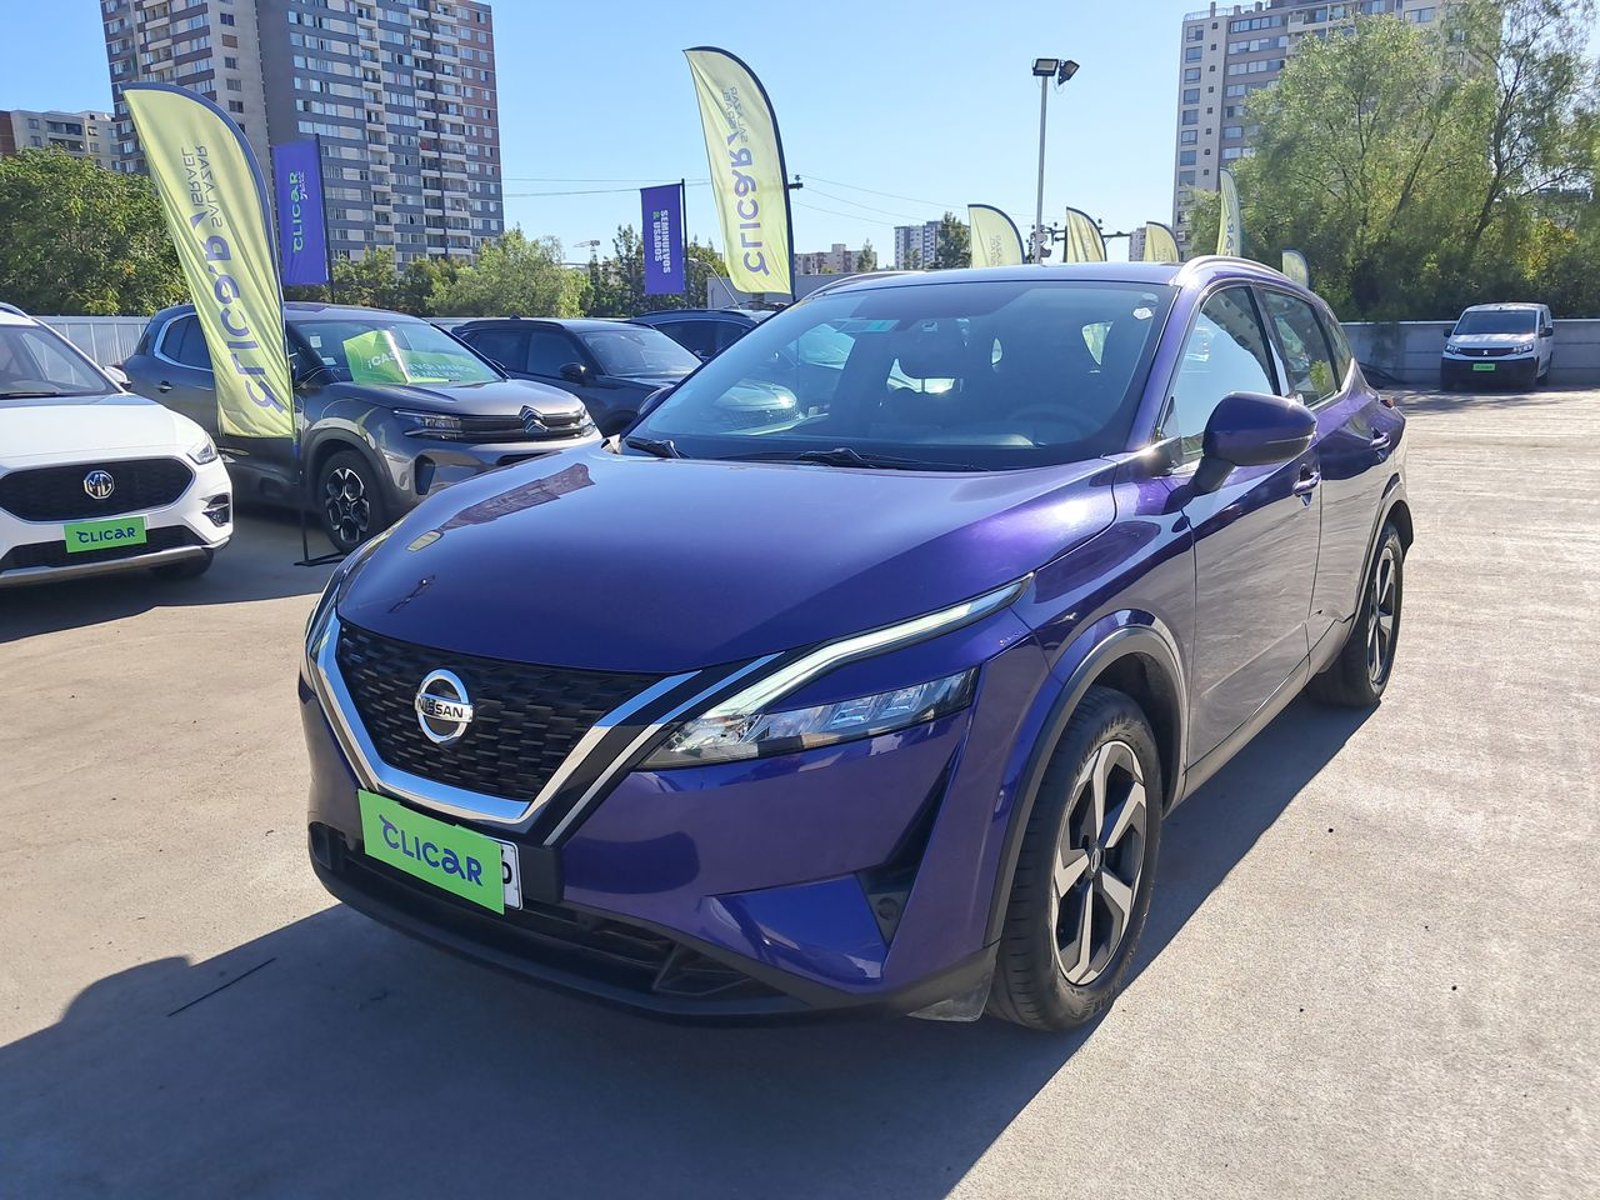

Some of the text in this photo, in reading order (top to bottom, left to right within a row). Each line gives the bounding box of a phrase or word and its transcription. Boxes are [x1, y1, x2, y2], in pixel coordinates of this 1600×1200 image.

[653, 221, 663, 262] USADOS
[660, 209, 671, 274] SEMINUEVOS
[88, 473, 112, 496] MG
[418, 698, 464, 718] NISSAN
